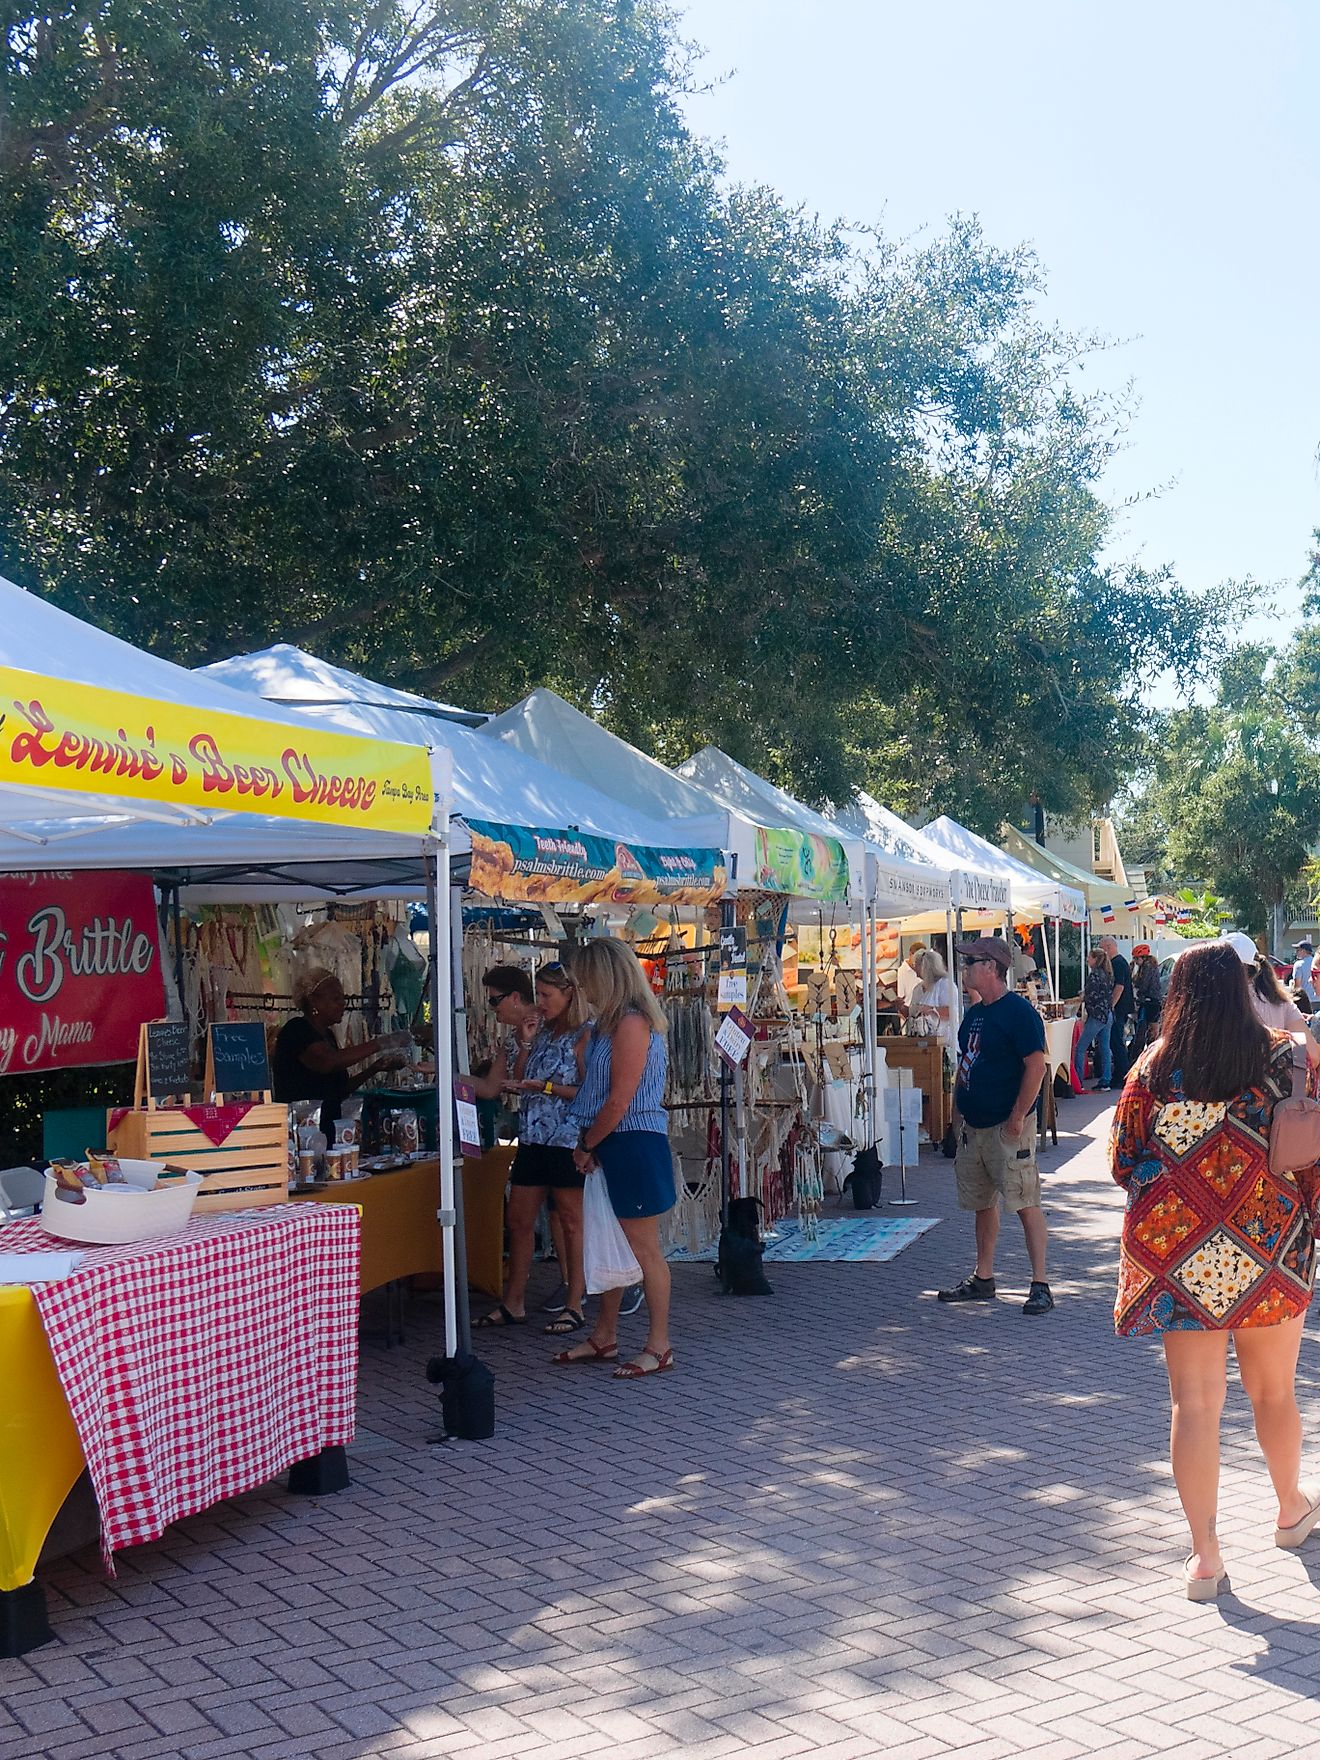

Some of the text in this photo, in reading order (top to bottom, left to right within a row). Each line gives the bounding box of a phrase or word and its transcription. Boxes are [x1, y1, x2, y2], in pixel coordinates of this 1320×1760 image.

[11, 700, 377, 811] Lennie's Beer Cheese
[382, 779, 400, 802] Tampa
[402, 783, 413, 804] Bay
[415, 785, 429, 801] Area
[533, 834, 557, 852] Teeth
[512, 857, 606, 881] psalmsbrittle.com
[16, 905, 154, 1001] Brittle
[23, 1012, 95, 1064] Mama
[213, 1026, 247, 1042] Free
[214, 1047, 265, 1070] Samples
